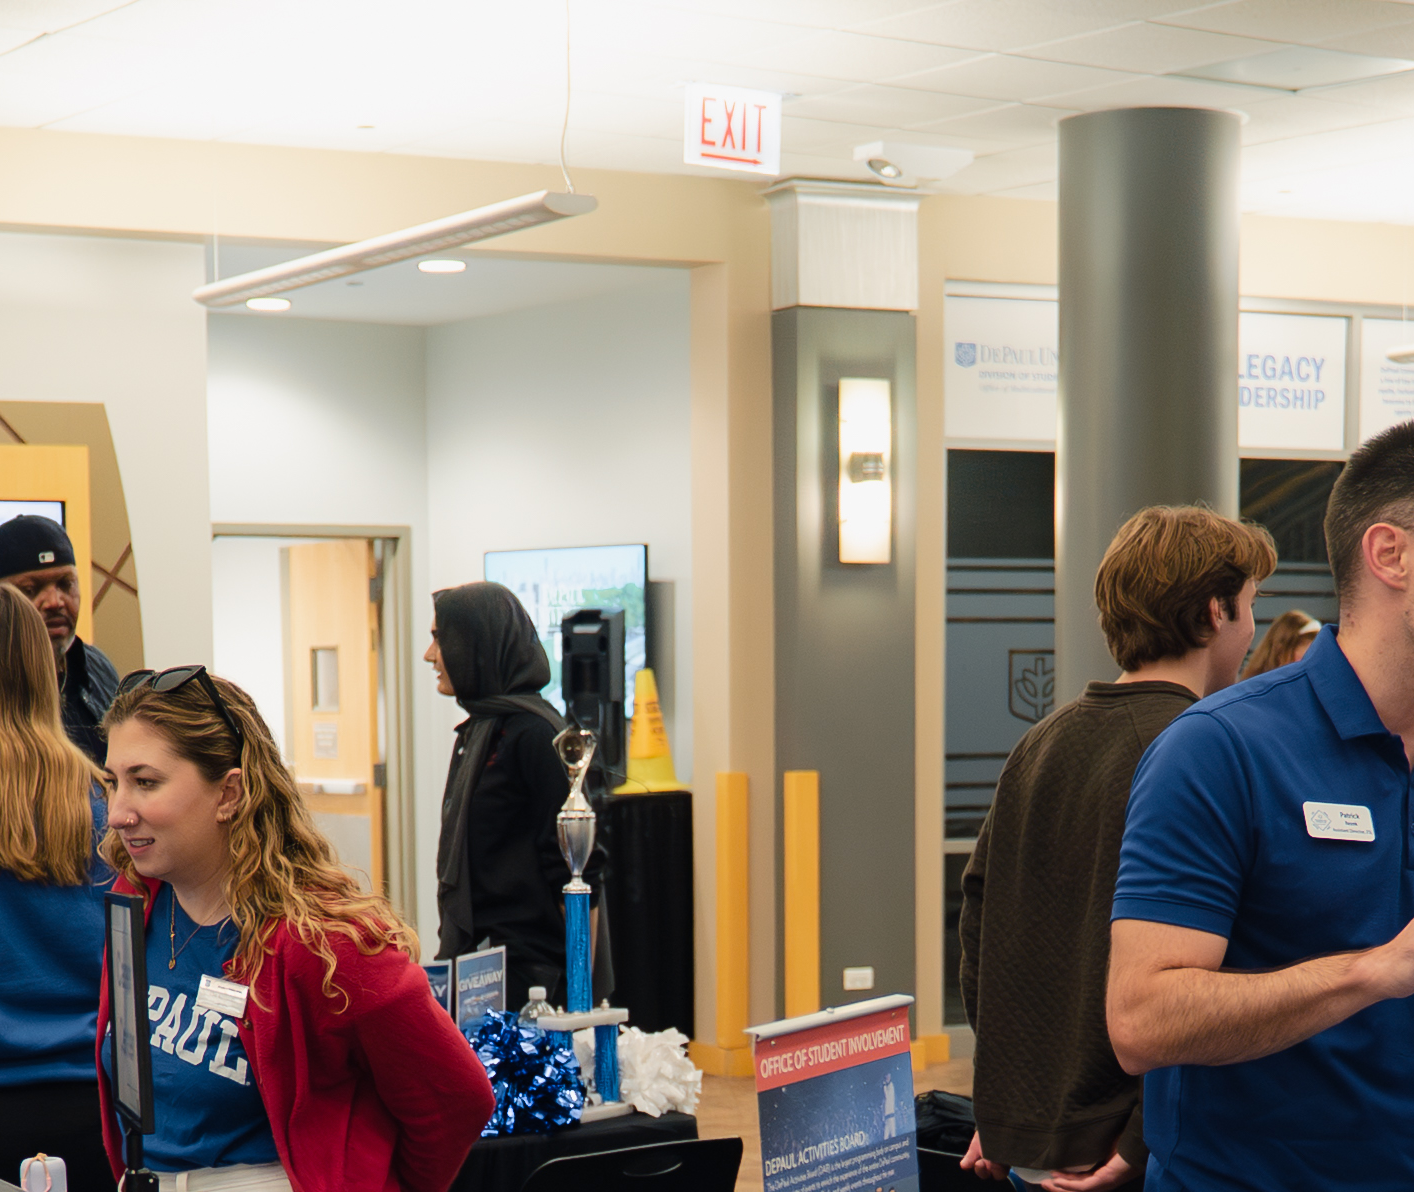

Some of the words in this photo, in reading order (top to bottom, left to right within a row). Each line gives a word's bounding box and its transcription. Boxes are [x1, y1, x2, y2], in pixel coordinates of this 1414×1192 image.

[701, 96, 767, 153] EXIT
[1032, 373, 1058, 382] STUD
[1238, 386, 1325, 410] DERSHIP
[459, 970, 503, 992] GIVEAWAY
[148, 984, 248, 1086] PAUL
[760, 1053, 794, 1078] OFFICE
[794, 1048, 808, 1070] OF
[808, 1039, 847, 1066] STUDENT
[848, 1024, 905, 1055] INVOLVEMENT
[765, 1155, 797, 1177] DEPAUL
[797, 1139, 838, 1166] ACTIVITIES
[839, 1130, 866, 1153] BOARD
